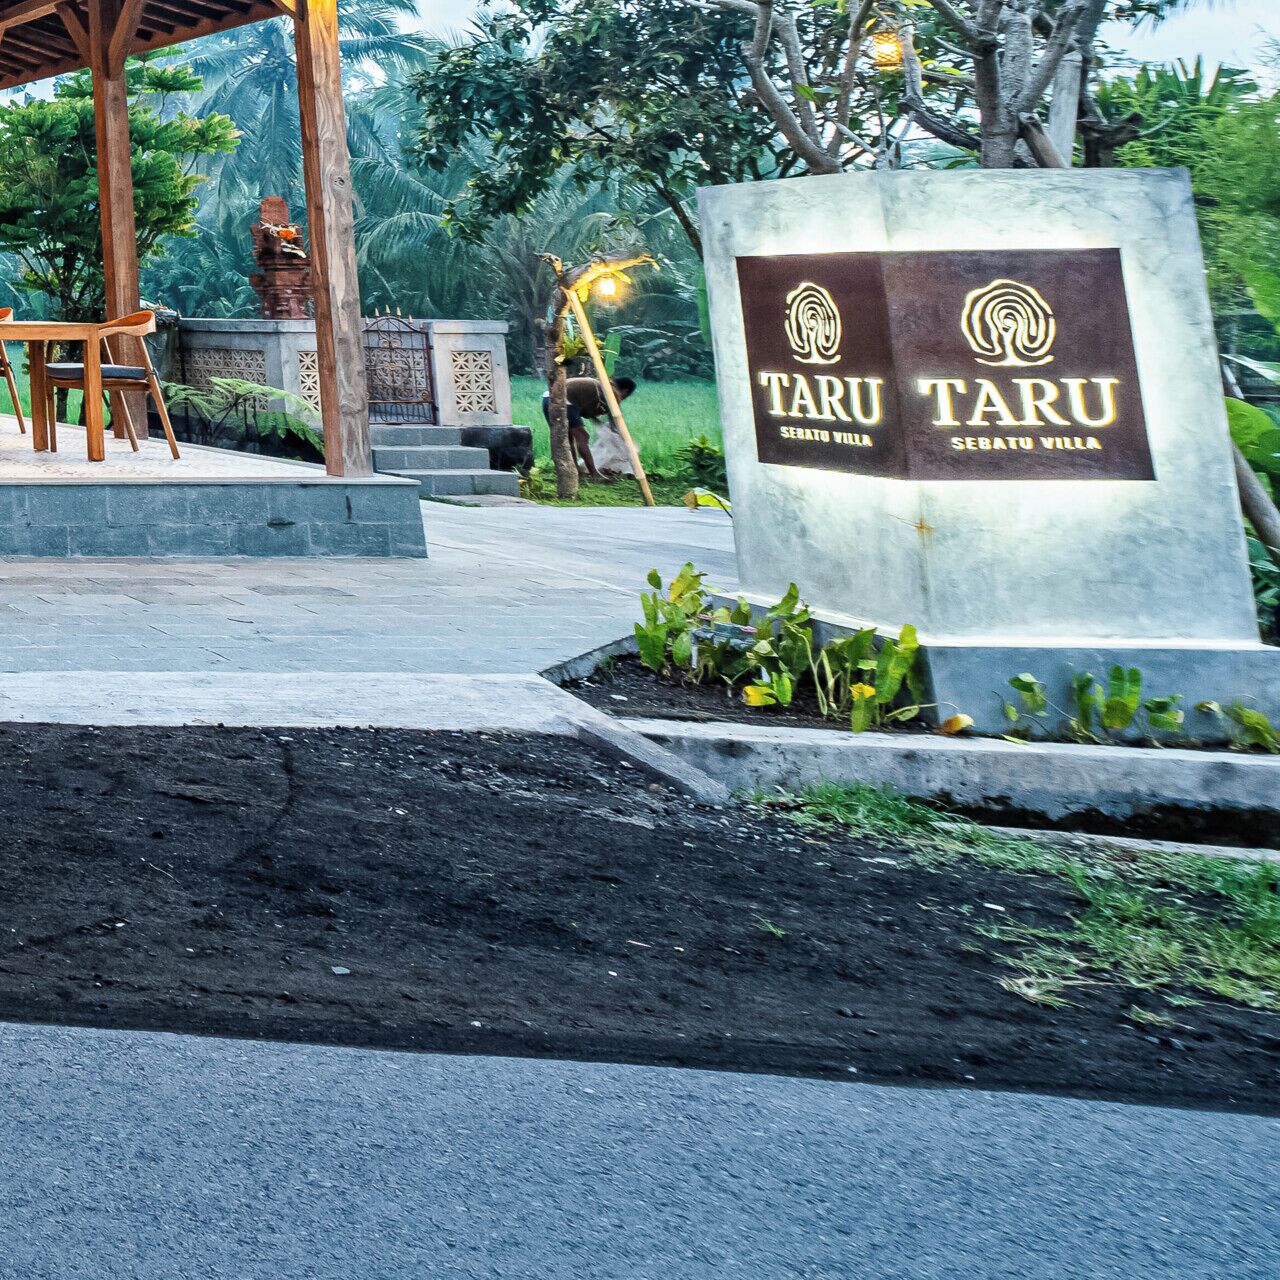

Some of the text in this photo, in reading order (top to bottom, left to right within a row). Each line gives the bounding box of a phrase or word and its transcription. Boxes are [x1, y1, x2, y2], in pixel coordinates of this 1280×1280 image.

[758, 370, 883, 426] TARU
[915, 376, 1120, 428] TARU
[780, 426, 873, 447] SEBATU VILLA
[950, 436, 1103, 451] SEBATU VILLA
